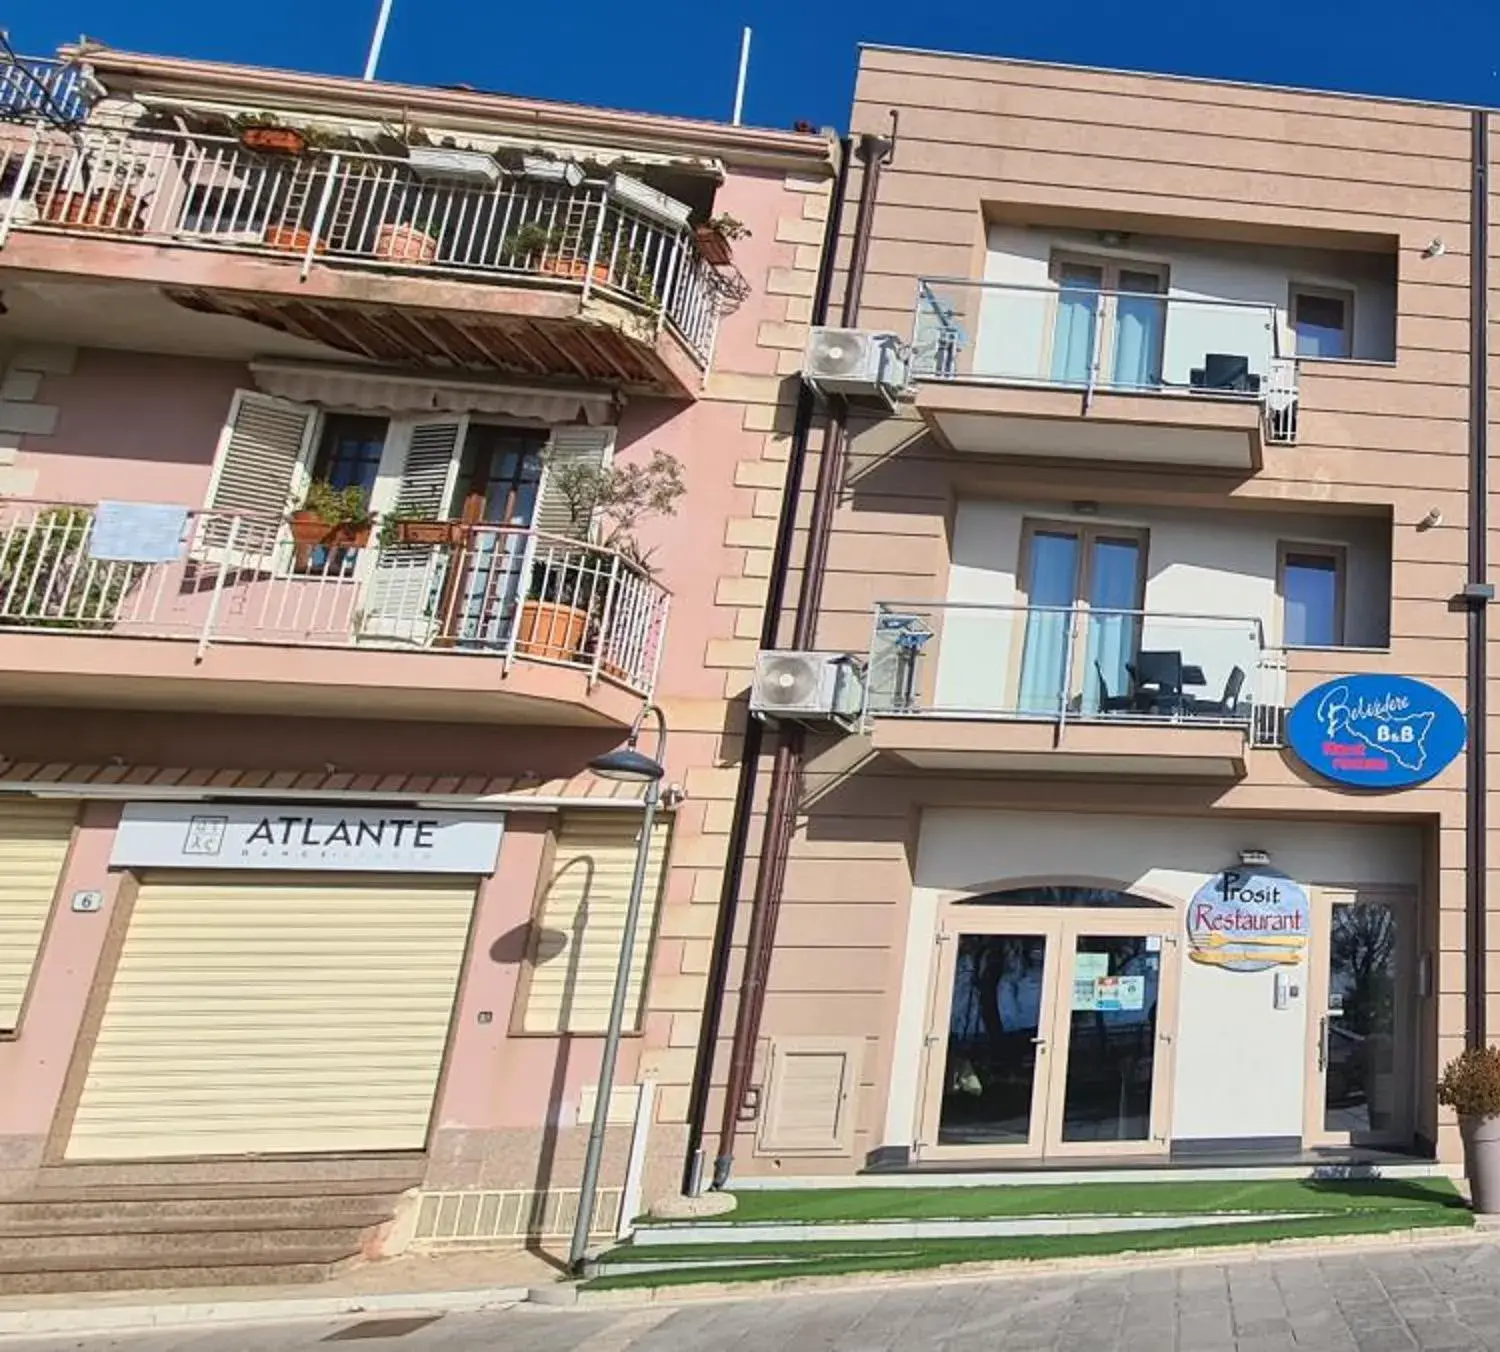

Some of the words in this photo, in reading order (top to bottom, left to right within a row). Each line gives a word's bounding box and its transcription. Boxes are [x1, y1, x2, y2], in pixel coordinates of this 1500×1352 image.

[1377, 725, 1414, 743] B&B
[246, 817, 438, 848] ATLANTE
[81, 894, 93, 909] 6
[1222, 871, 1281, 904] Prosit
[1195, 903, 1302, 931] Restaurant
